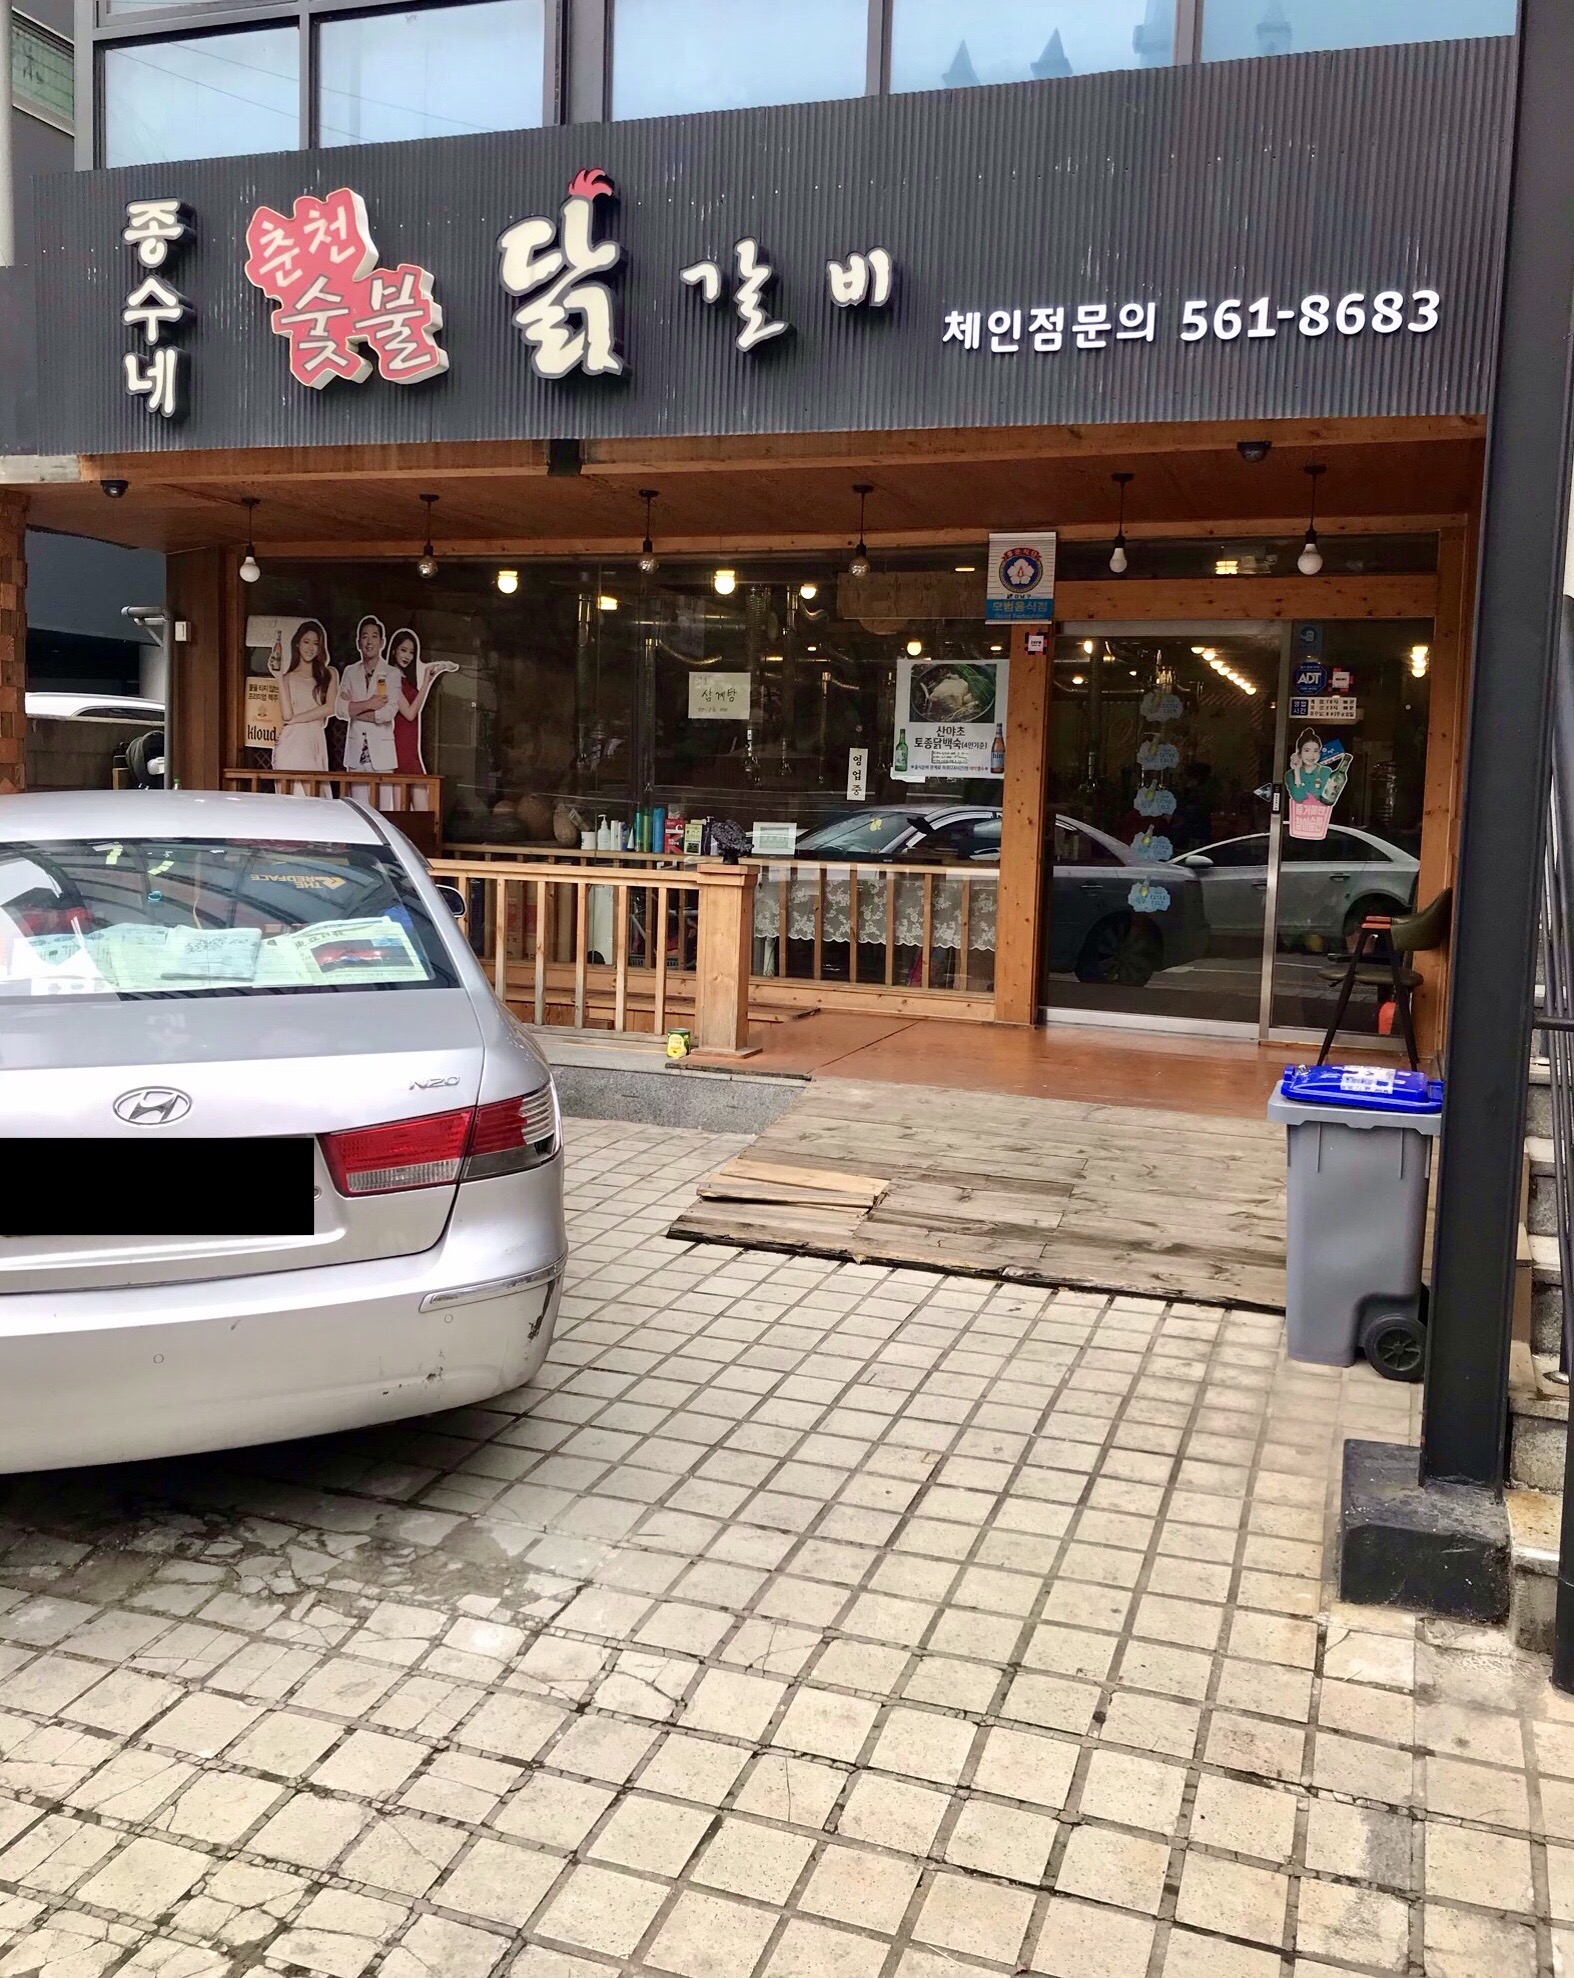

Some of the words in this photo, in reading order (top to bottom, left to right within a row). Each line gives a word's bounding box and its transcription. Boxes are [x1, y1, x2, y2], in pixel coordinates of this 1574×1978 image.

[257, 203, 365, 290] 춘천
[122, 199, 185, 417] 종수네
[279, 272, 437, 374] 숯불
[942, 302, 1157, 354] 체인점문의
[1179, 288, 1440, 343] 561-8683
[1297, 672, 1321, 684] ADT
[936, 726, 965, 737] 산야초
[852, 754, 862, 796] 영업중
[408, 1076, 460, 1091] N20
